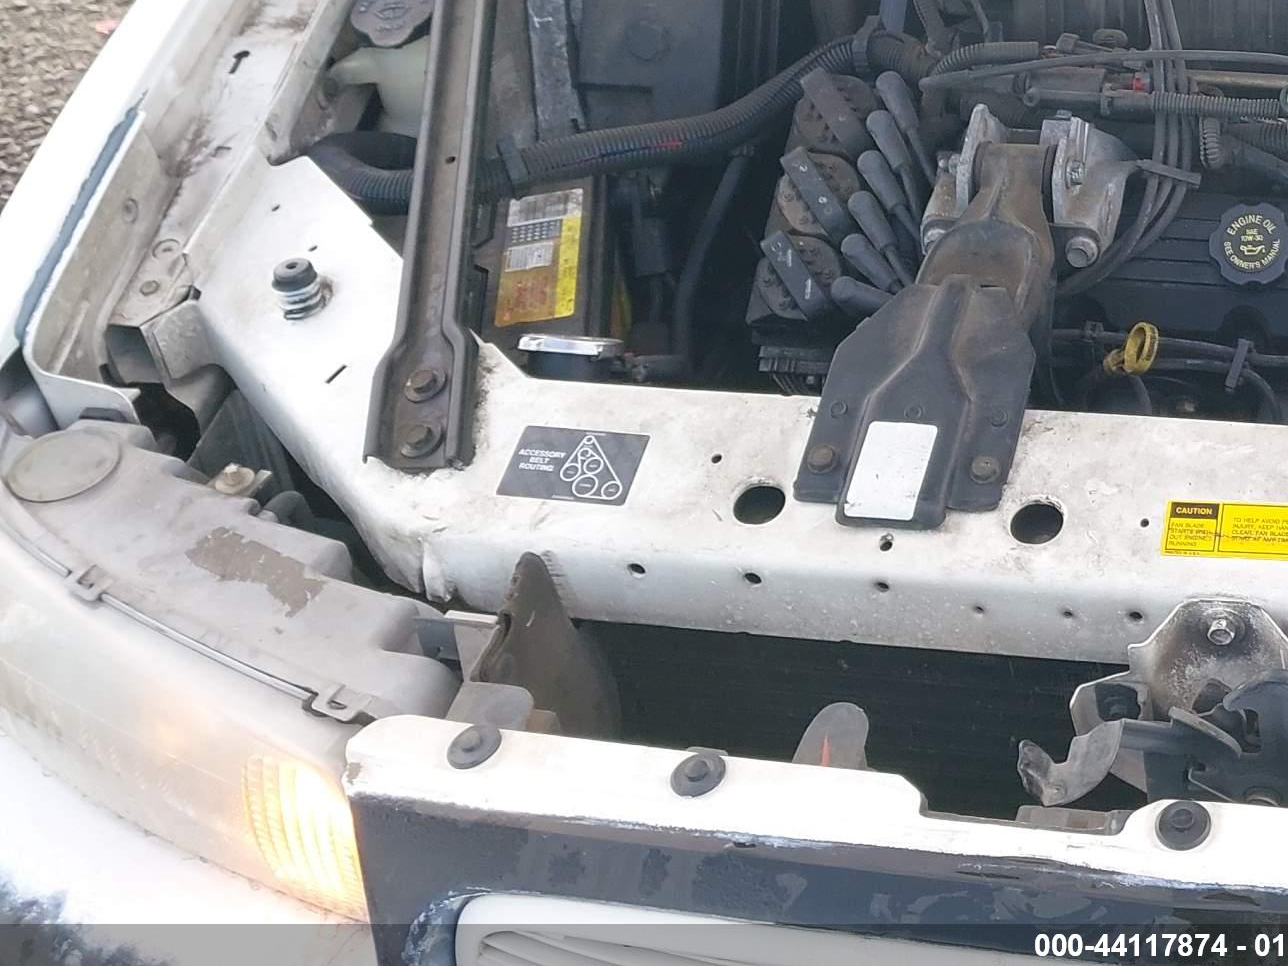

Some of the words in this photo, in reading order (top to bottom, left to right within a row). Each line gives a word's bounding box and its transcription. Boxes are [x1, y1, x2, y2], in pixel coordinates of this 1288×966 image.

[1226, 214, 1262, 235] ENGINE
[1262, 219, 1276, 234] OIL
[1224, 241, 1234, 256] SEE
[1229, 254, 1260, 269] OWNER'S
[1261, 238, 1280, 266] MANUAL
[518, 448, 566, 459] ACCESSORY
[529, 456, 549, 464] BELT
[519, 463, 554, 472] ROUTING
[1175, 506, 1212, 515] CAUTION
